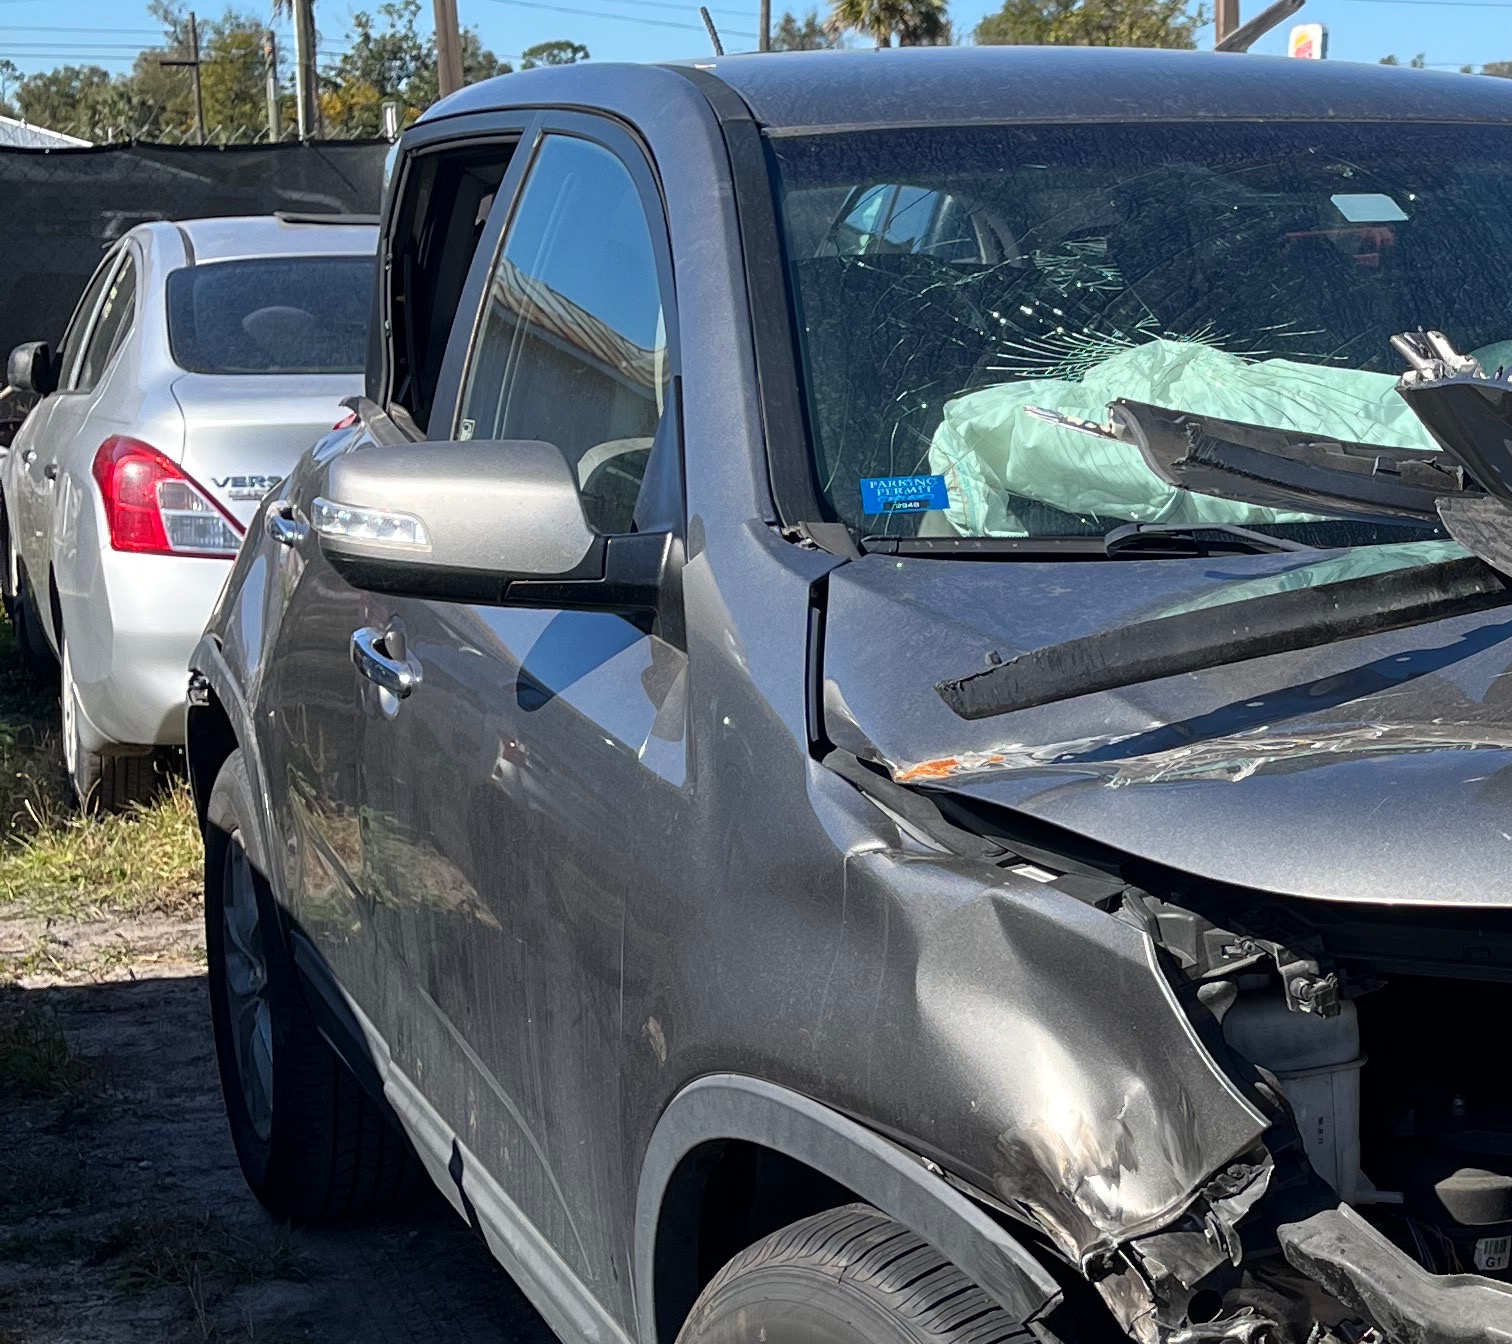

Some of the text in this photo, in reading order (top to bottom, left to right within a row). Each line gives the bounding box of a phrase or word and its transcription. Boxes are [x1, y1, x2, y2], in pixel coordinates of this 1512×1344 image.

[211, 476, 283, 488] VERS
[869, 477, 937, 488] PARKING
[877, 486, 932, 496] PERMIT
[1485, 1256, 1501, 1268] G1
